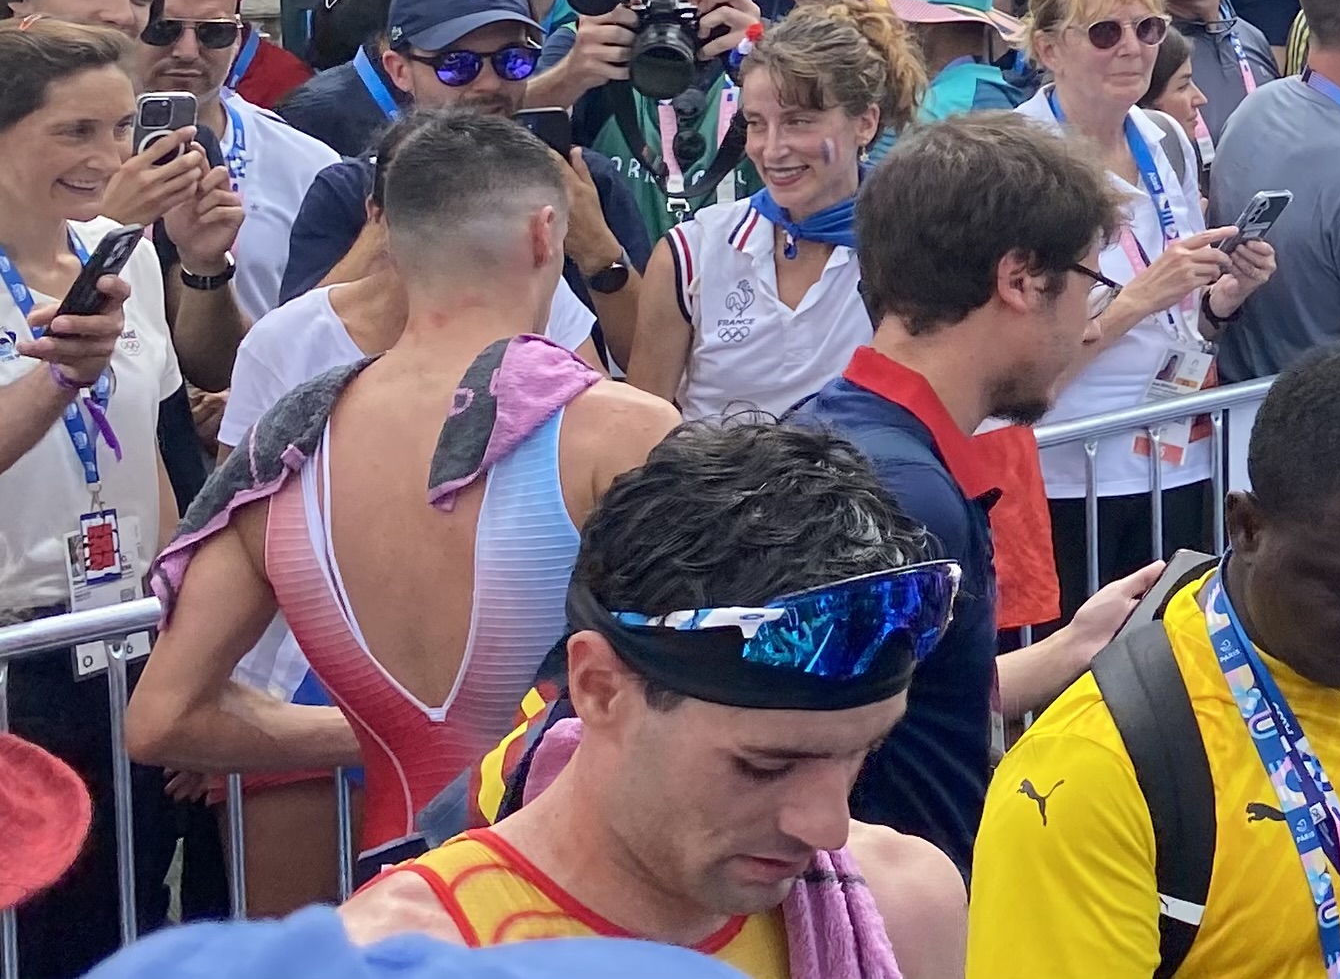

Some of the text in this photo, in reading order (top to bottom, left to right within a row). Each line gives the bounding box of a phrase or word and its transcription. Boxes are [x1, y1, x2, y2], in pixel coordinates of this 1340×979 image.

[718, 318, 755, 326] FRANCE
[1220, 649, 1241, 663] PARIS
[1297, 830, 1315, 844] PARIS
